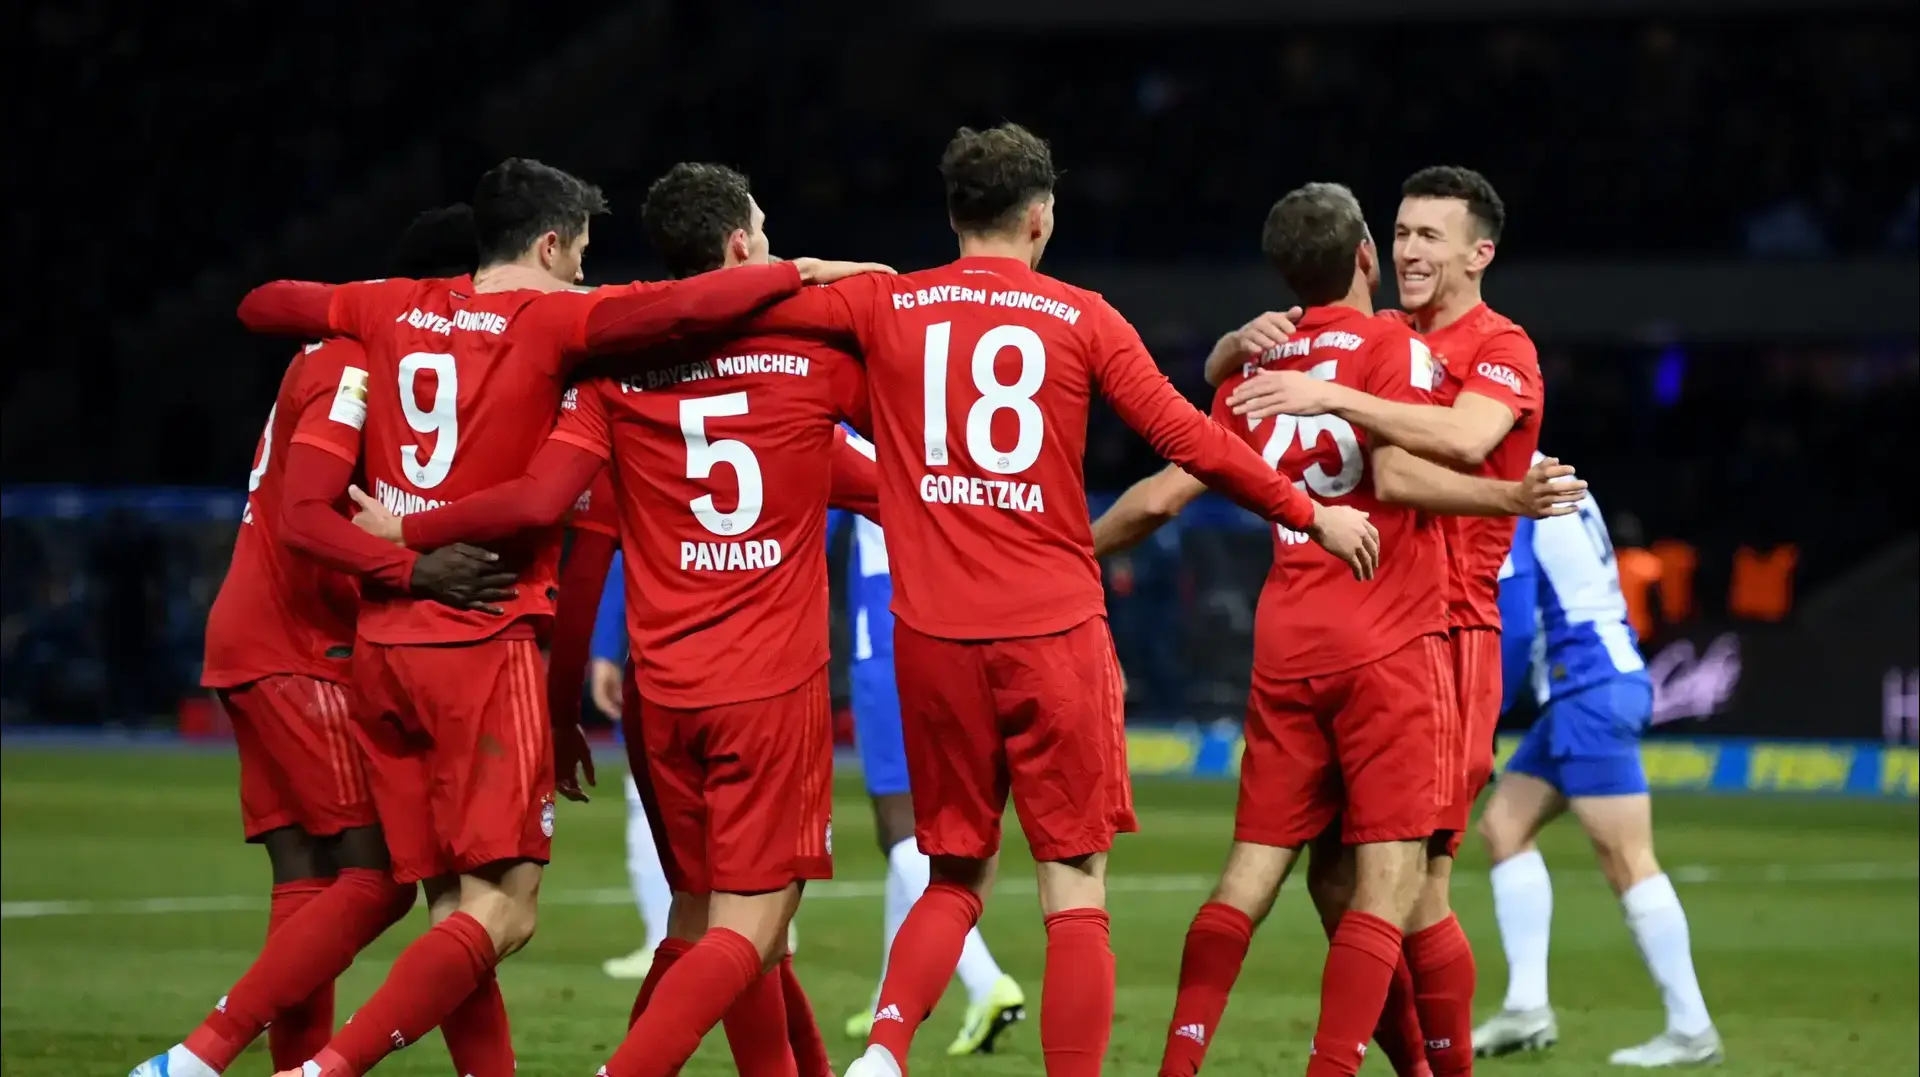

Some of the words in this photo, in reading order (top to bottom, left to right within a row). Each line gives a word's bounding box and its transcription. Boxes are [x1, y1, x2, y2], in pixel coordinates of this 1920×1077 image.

[893, 293, 915, 309] FC
[916, 285, 986, 306] BAYERN
[990, 290, 1081, 325] MÜNCHEN
[620, 373, 644, 394] FC
[646, 360, 715, 389] BAYERN
[716, 354, 809, 377] MÜNCHEN
[924, 320, 1047, 475] 18
[398, 352, 459, 489] 9
[679, 391, 764, 537] 5
[920, 474, 1045, 513] GORETZKA
[680, 539, 782, 571] PAVARD
